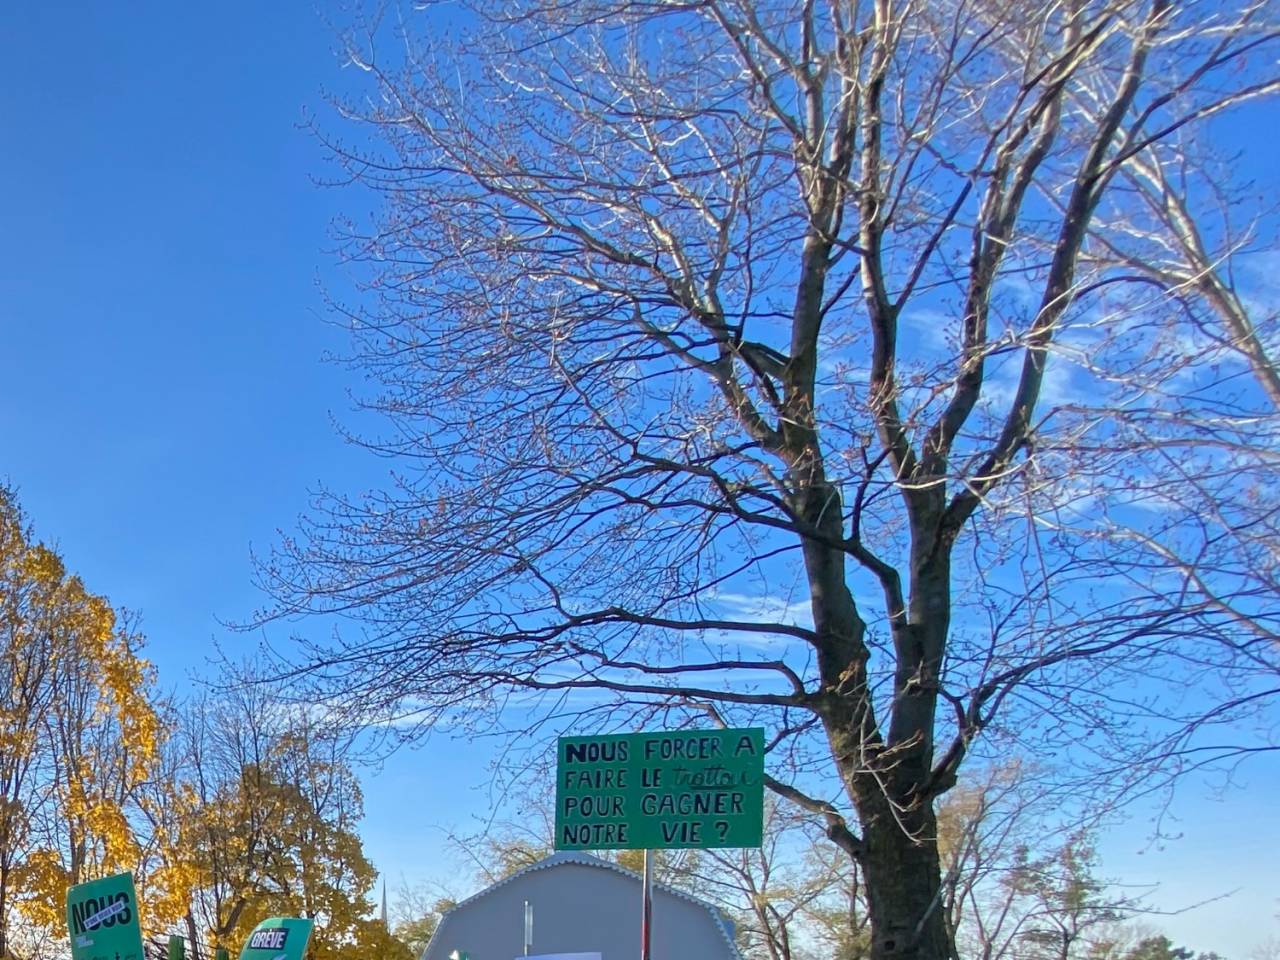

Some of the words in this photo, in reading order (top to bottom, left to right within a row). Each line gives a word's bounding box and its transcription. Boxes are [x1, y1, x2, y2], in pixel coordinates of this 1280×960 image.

[566, 741, 628, 762] NOUS
[645, 738, 722, 760] FORCER
[735, 735, 755, 756] A
[565, 769, 627, 789] FAIRE
[641, 768, 661, 788] LE
[565, 796, 625, 817] POUR
[642, 793, 744, 816] GAGNER
[563, 823, 628, 845] NOTRE
[661, 822, 702, 844] VIE
[72, 892, 132, 934] NOUS
[251, 929, 286, 948] GRÈVE
